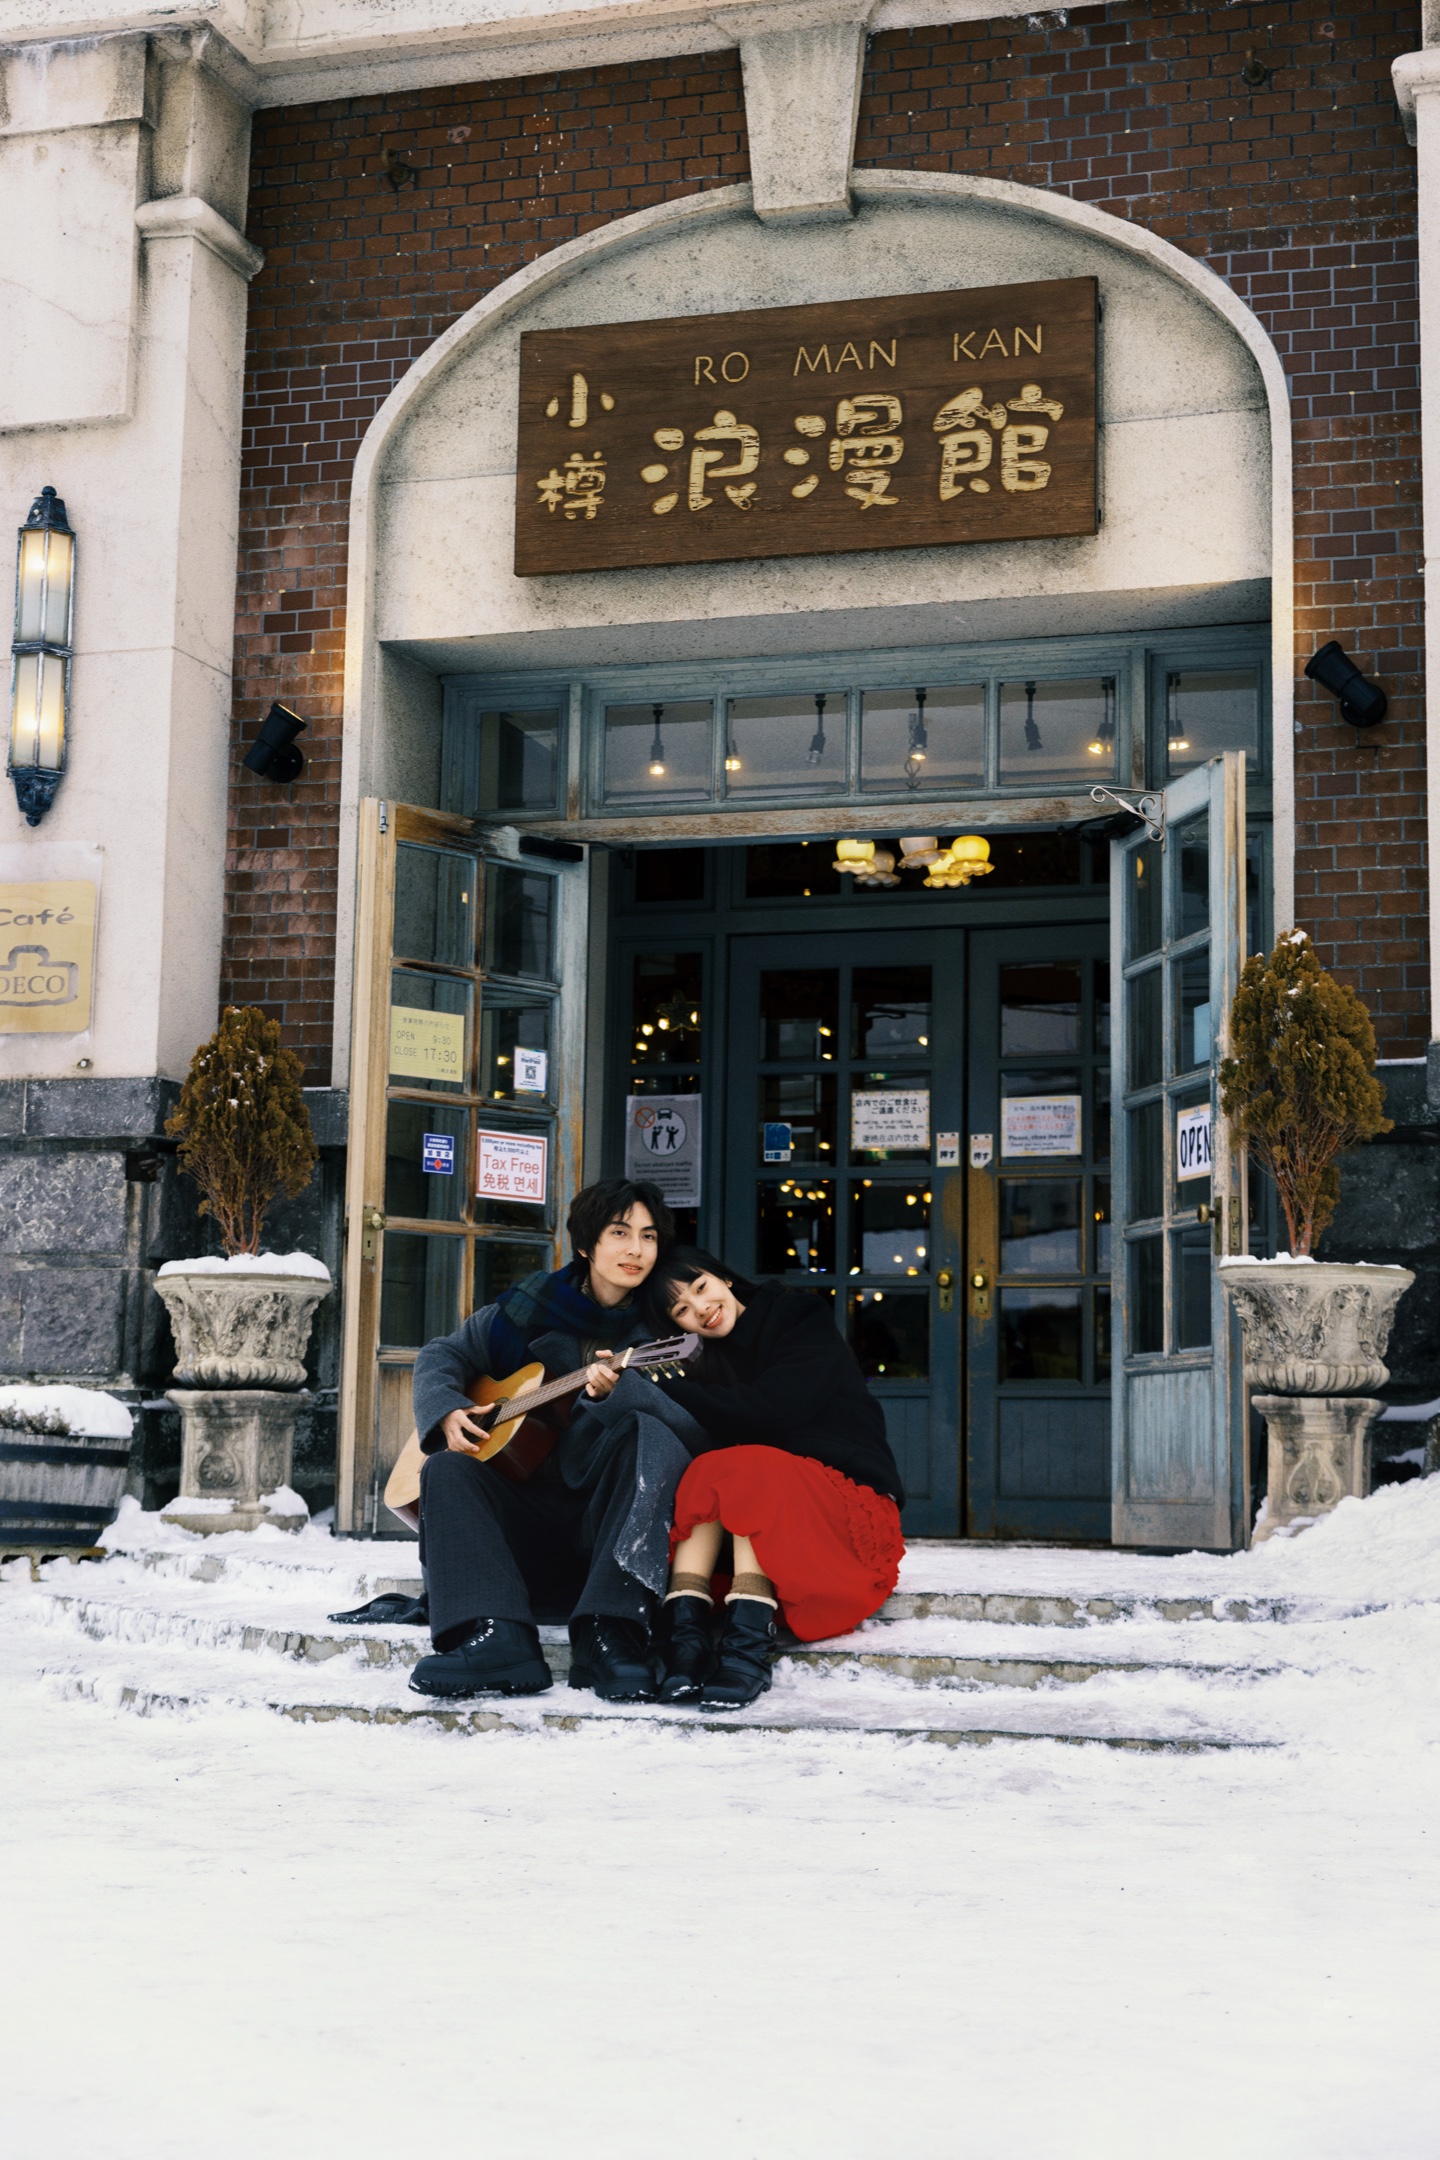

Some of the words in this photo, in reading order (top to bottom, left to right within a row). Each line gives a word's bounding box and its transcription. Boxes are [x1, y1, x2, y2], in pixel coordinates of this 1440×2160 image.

[694, 350, 750, 386] RO
[793, 338, 898, 377] MAN
[952, 324, 1043, 362] KAN
[536, 373, 615, 520] 小樽
[641, 383, 1064, 516] 浪漫館
[396, 1030, 415, 1040] OPEN
[432, 1035, 451, 1045] 9:30
[394, 1045, 417, 1057] CLOSE
[423, 1048, 457, 1063] 17:30
[871, 1106, 926, 1115] ご遠慮ください
[940, 1150, 956, 1159] 押す
[1180, 1122, 1211, 1168] OPEN
[483, 1154, 507, 1171] Tax
[510, 1157, 540, 1175] Free
[974, 1152, 990, 1161] 押す
[483, 1172, 510, 1191] 免税
[514, 1176, 538, 1194] 면세
